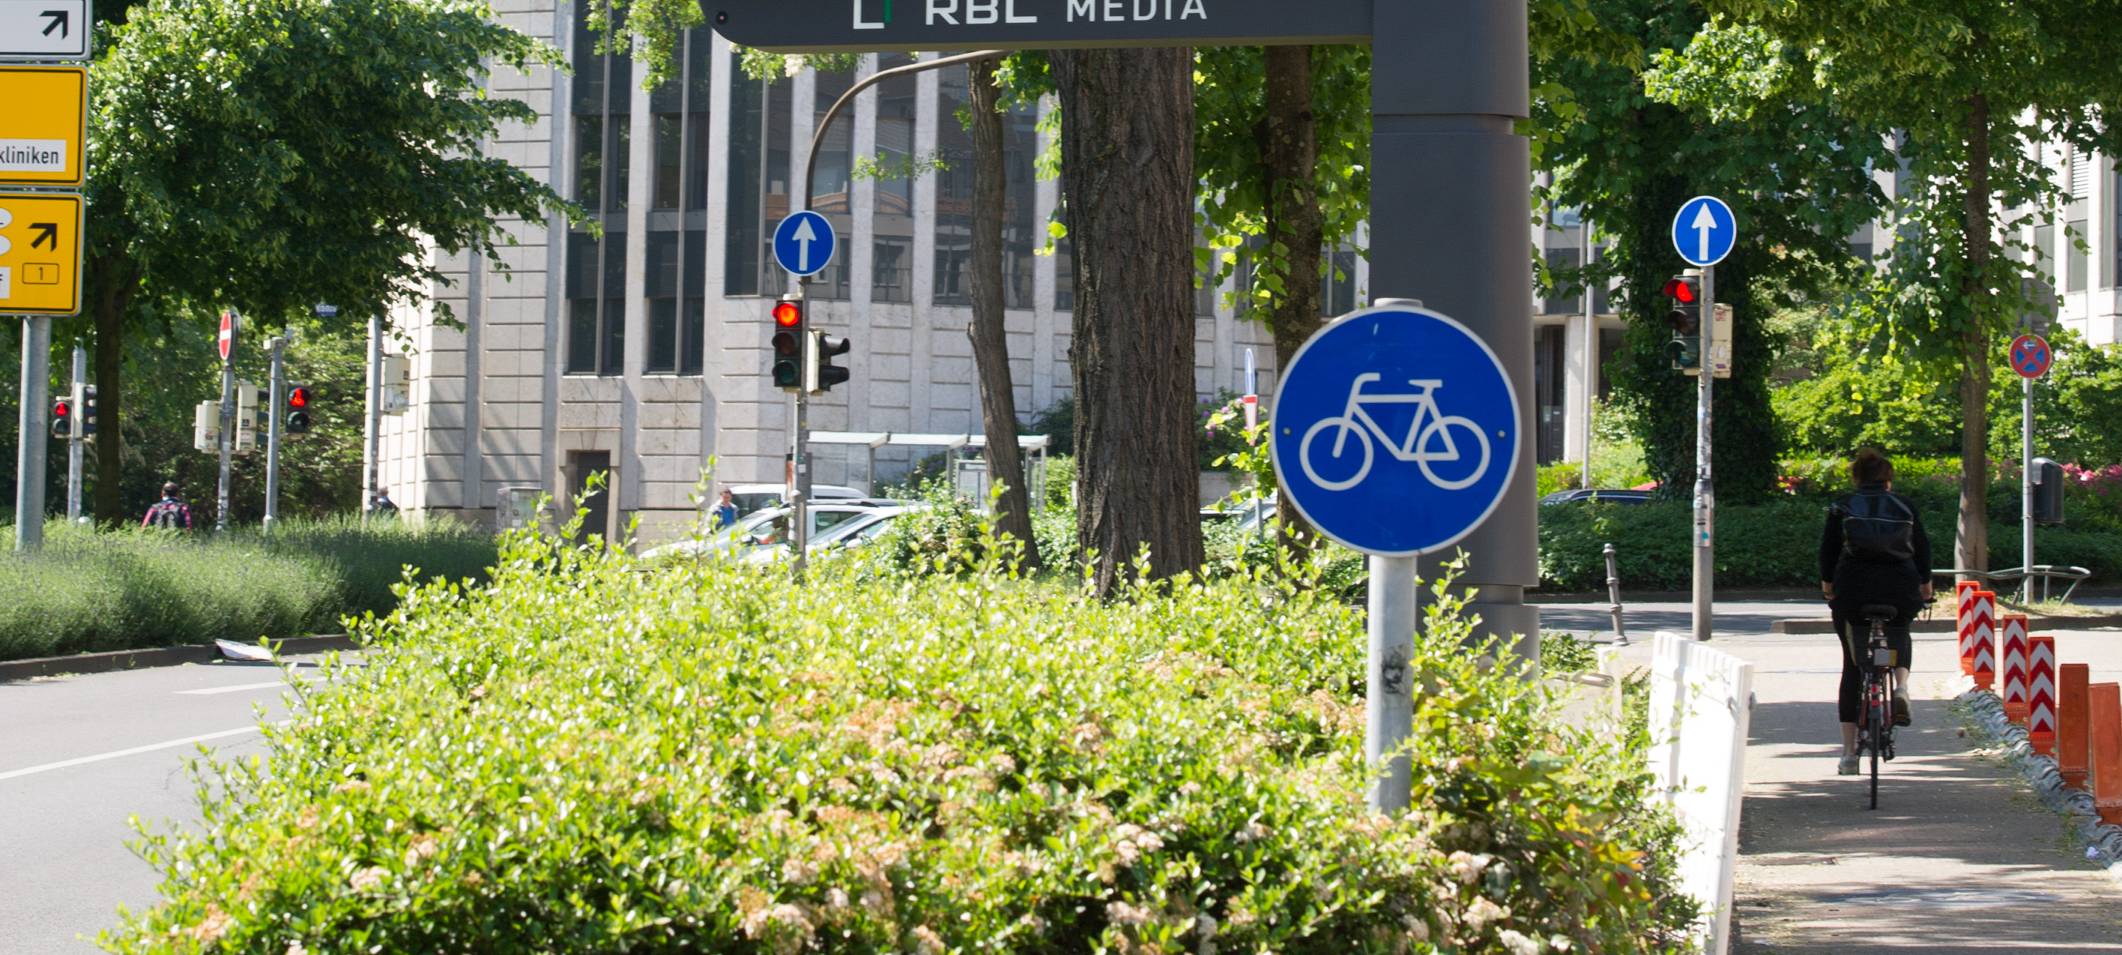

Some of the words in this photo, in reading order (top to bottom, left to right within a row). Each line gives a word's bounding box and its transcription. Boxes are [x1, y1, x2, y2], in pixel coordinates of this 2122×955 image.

[925, 0, 1038, 26] RBL
[1066, 0, 1208, 23] MEDIA
[38, 266, 44, 281] 1
